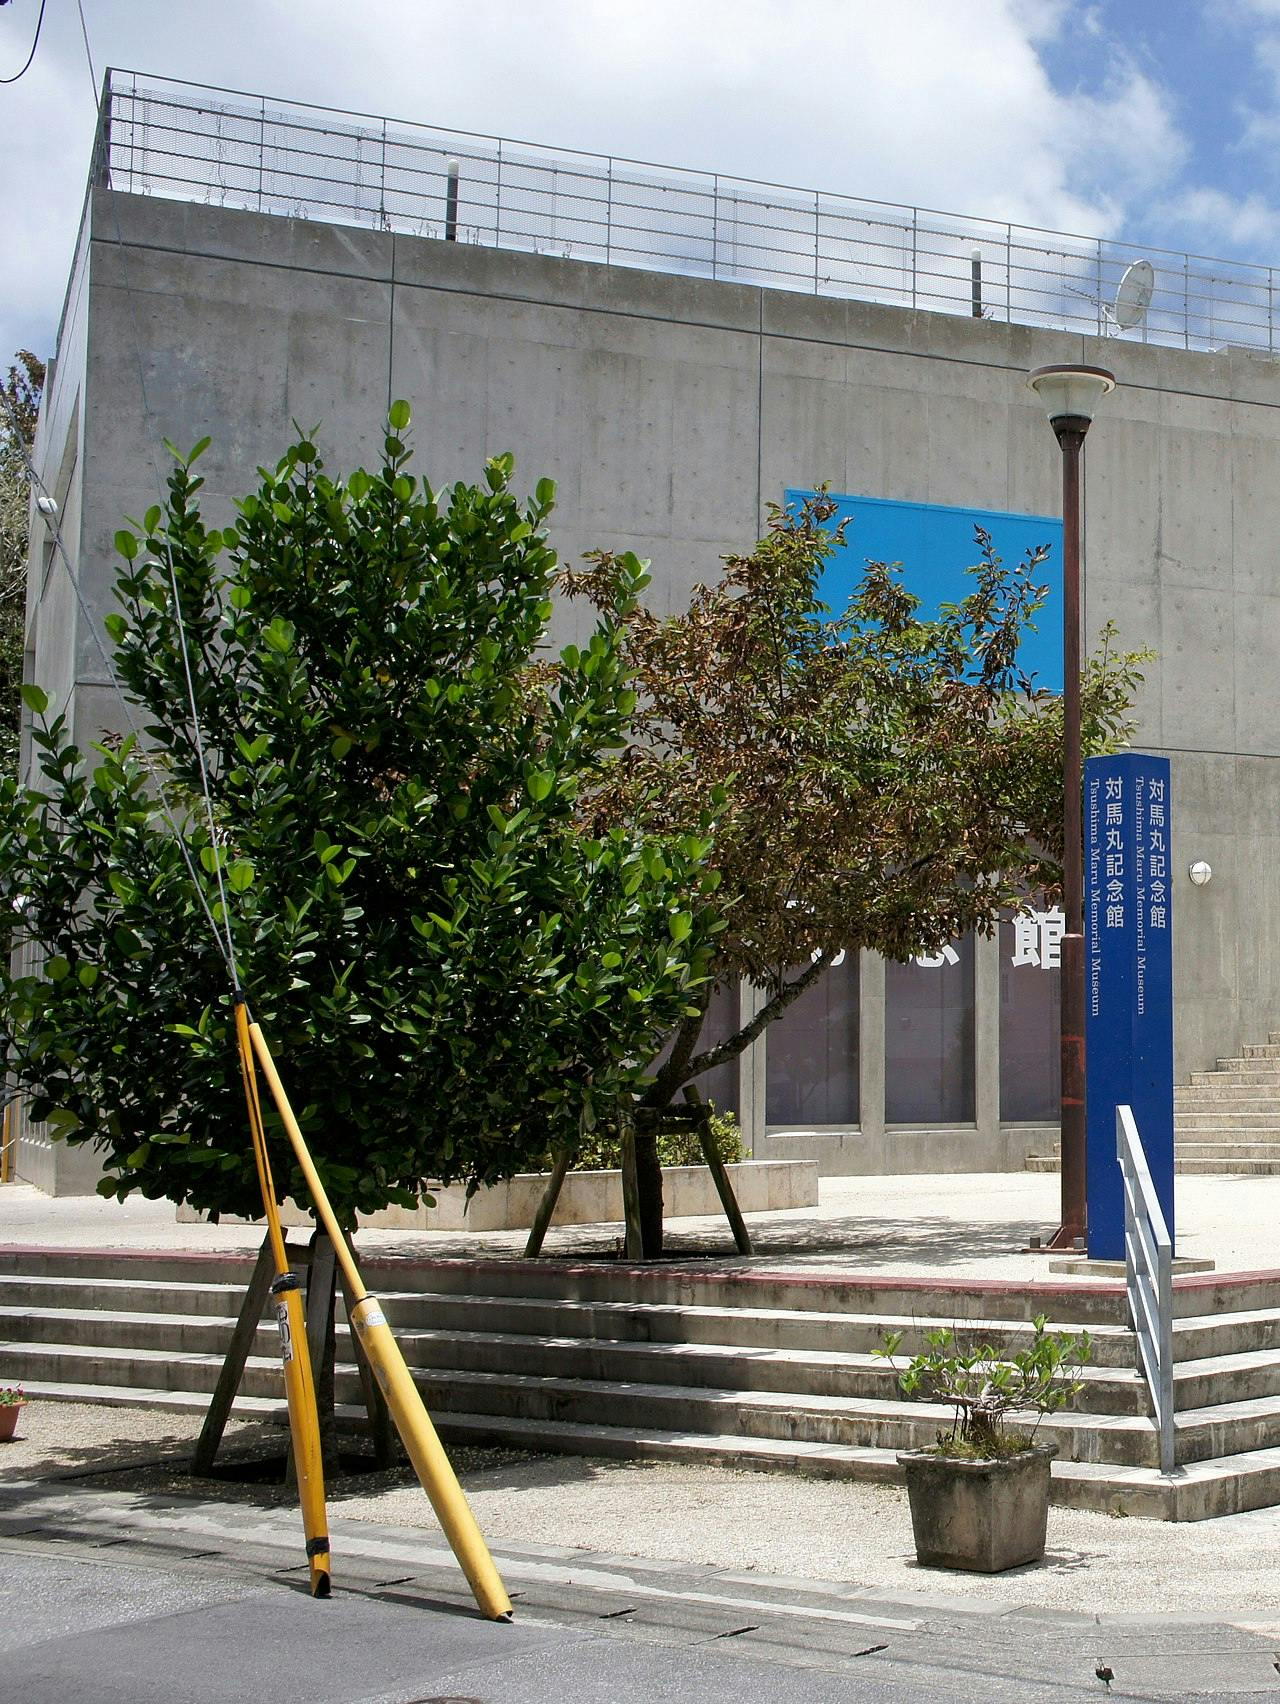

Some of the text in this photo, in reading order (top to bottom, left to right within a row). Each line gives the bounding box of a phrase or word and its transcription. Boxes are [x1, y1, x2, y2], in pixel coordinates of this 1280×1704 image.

[1090, 778, 1101, 1016] Tsushima Maru Memorial Museum
[1105, 776, 1124, 928] 対馬丸記念館
[1135, 775, 1146, 1015] Tsushima Maru Memorial Museum
[1148, 778, 1166, 929] 対馬丸記念館
